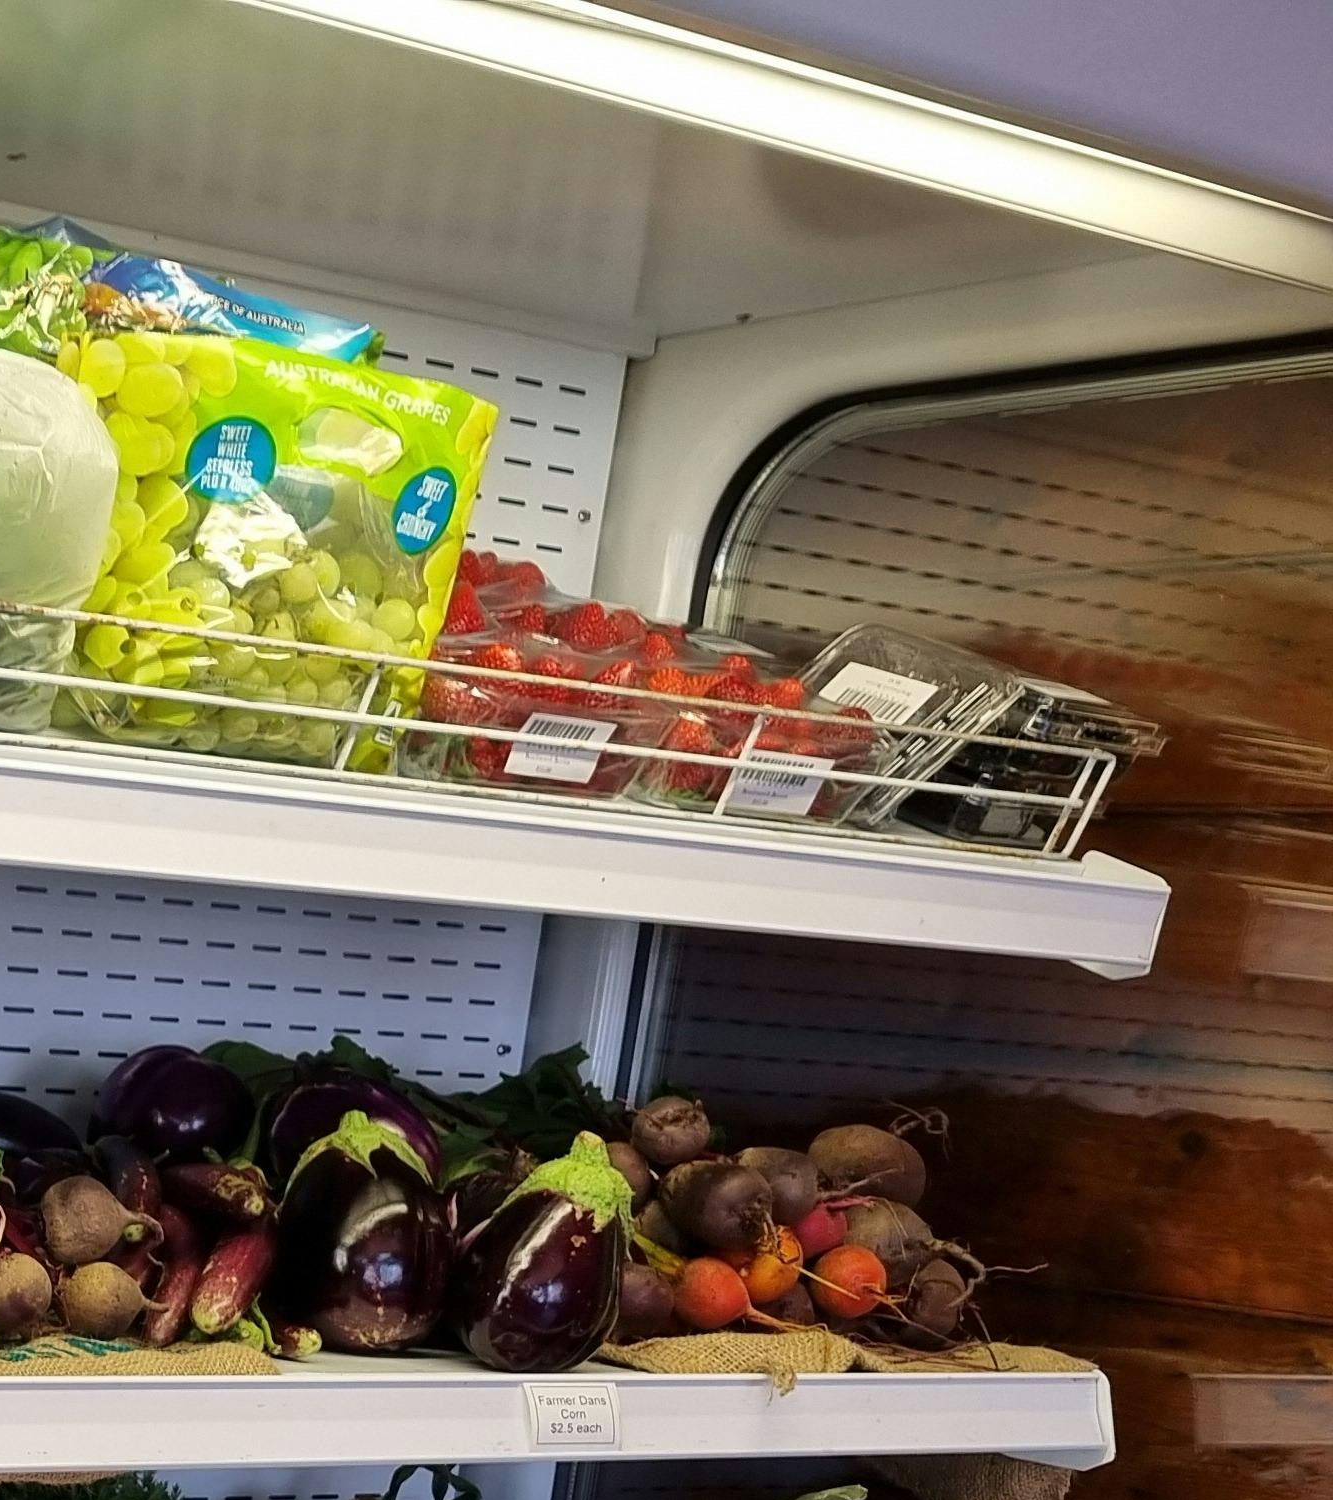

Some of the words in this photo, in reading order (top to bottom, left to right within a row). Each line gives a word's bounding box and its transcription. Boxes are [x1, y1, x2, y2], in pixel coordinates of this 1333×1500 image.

[233, 303, 244, 317] OF
[246, 310, 305, 335] AUSTRALIA
[265, 360, 380, 402] AUSTRALIAN
[384, 390, 451, 426] GRAPES
[220, 425, 253, 441] SWEET
[217, 441, 248, 458] WHITE
[205, 457, 253, 477] SEEDLESS
[417, 475, 449, 502] SWEET
[397, 511, 436, 541] CRUNCHY
[538, 1395, 576, 1406] Farmer
[578, 1395, 607, 1406] Dans
[561, 1409, 586, 1419] Corn
[550, 1423, 573, 1434] $2.5
[576, 1423, 602, 1433] each
